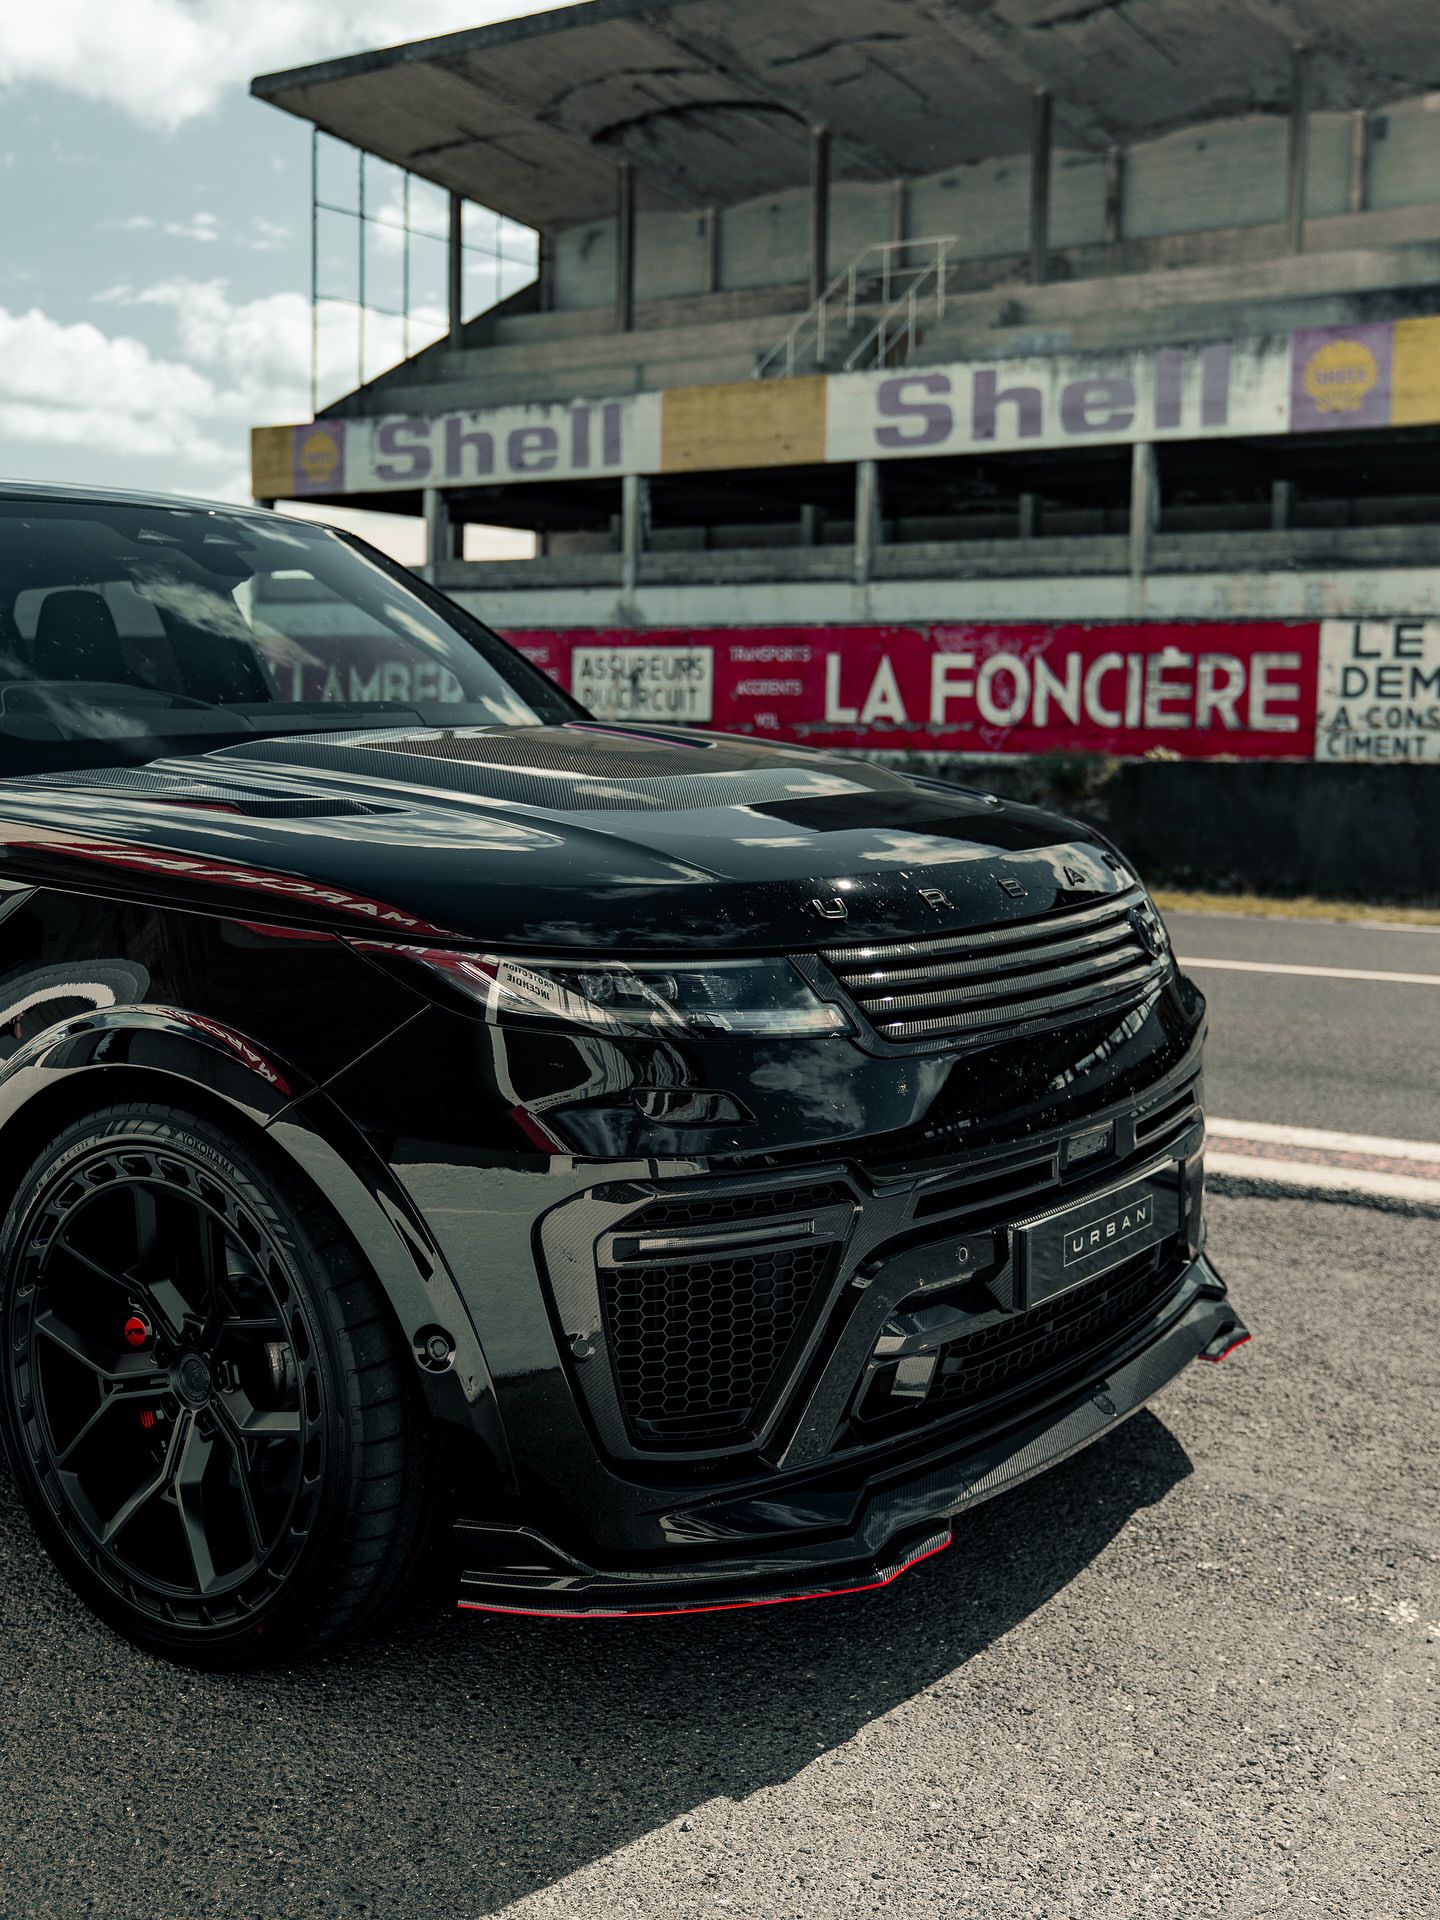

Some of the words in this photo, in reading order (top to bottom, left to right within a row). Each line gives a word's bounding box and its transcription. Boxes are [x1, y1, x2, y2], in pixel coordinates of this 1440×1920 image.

[875, 345, 1230, 450] Shell
[375, 402, 622, 483] Shell
[729, 645, 812, 663] TRANSPORTS
[1353, 623, 1425, 658] LE
[581, 655, 705, 681] ASSUREURS
[825, 651, 908, 725] LA
[929, 646, 1301, 733] FONCIÈRE
[1331, 705, 1351, 730] A
[1326, 732, 1425, 758] CIMENT
[812, 851, 1122, 920] URBAN
[181, 1132, 235, 1178] YOKOHAMA
[1072, 1207, 1147, 1253] URBAN
